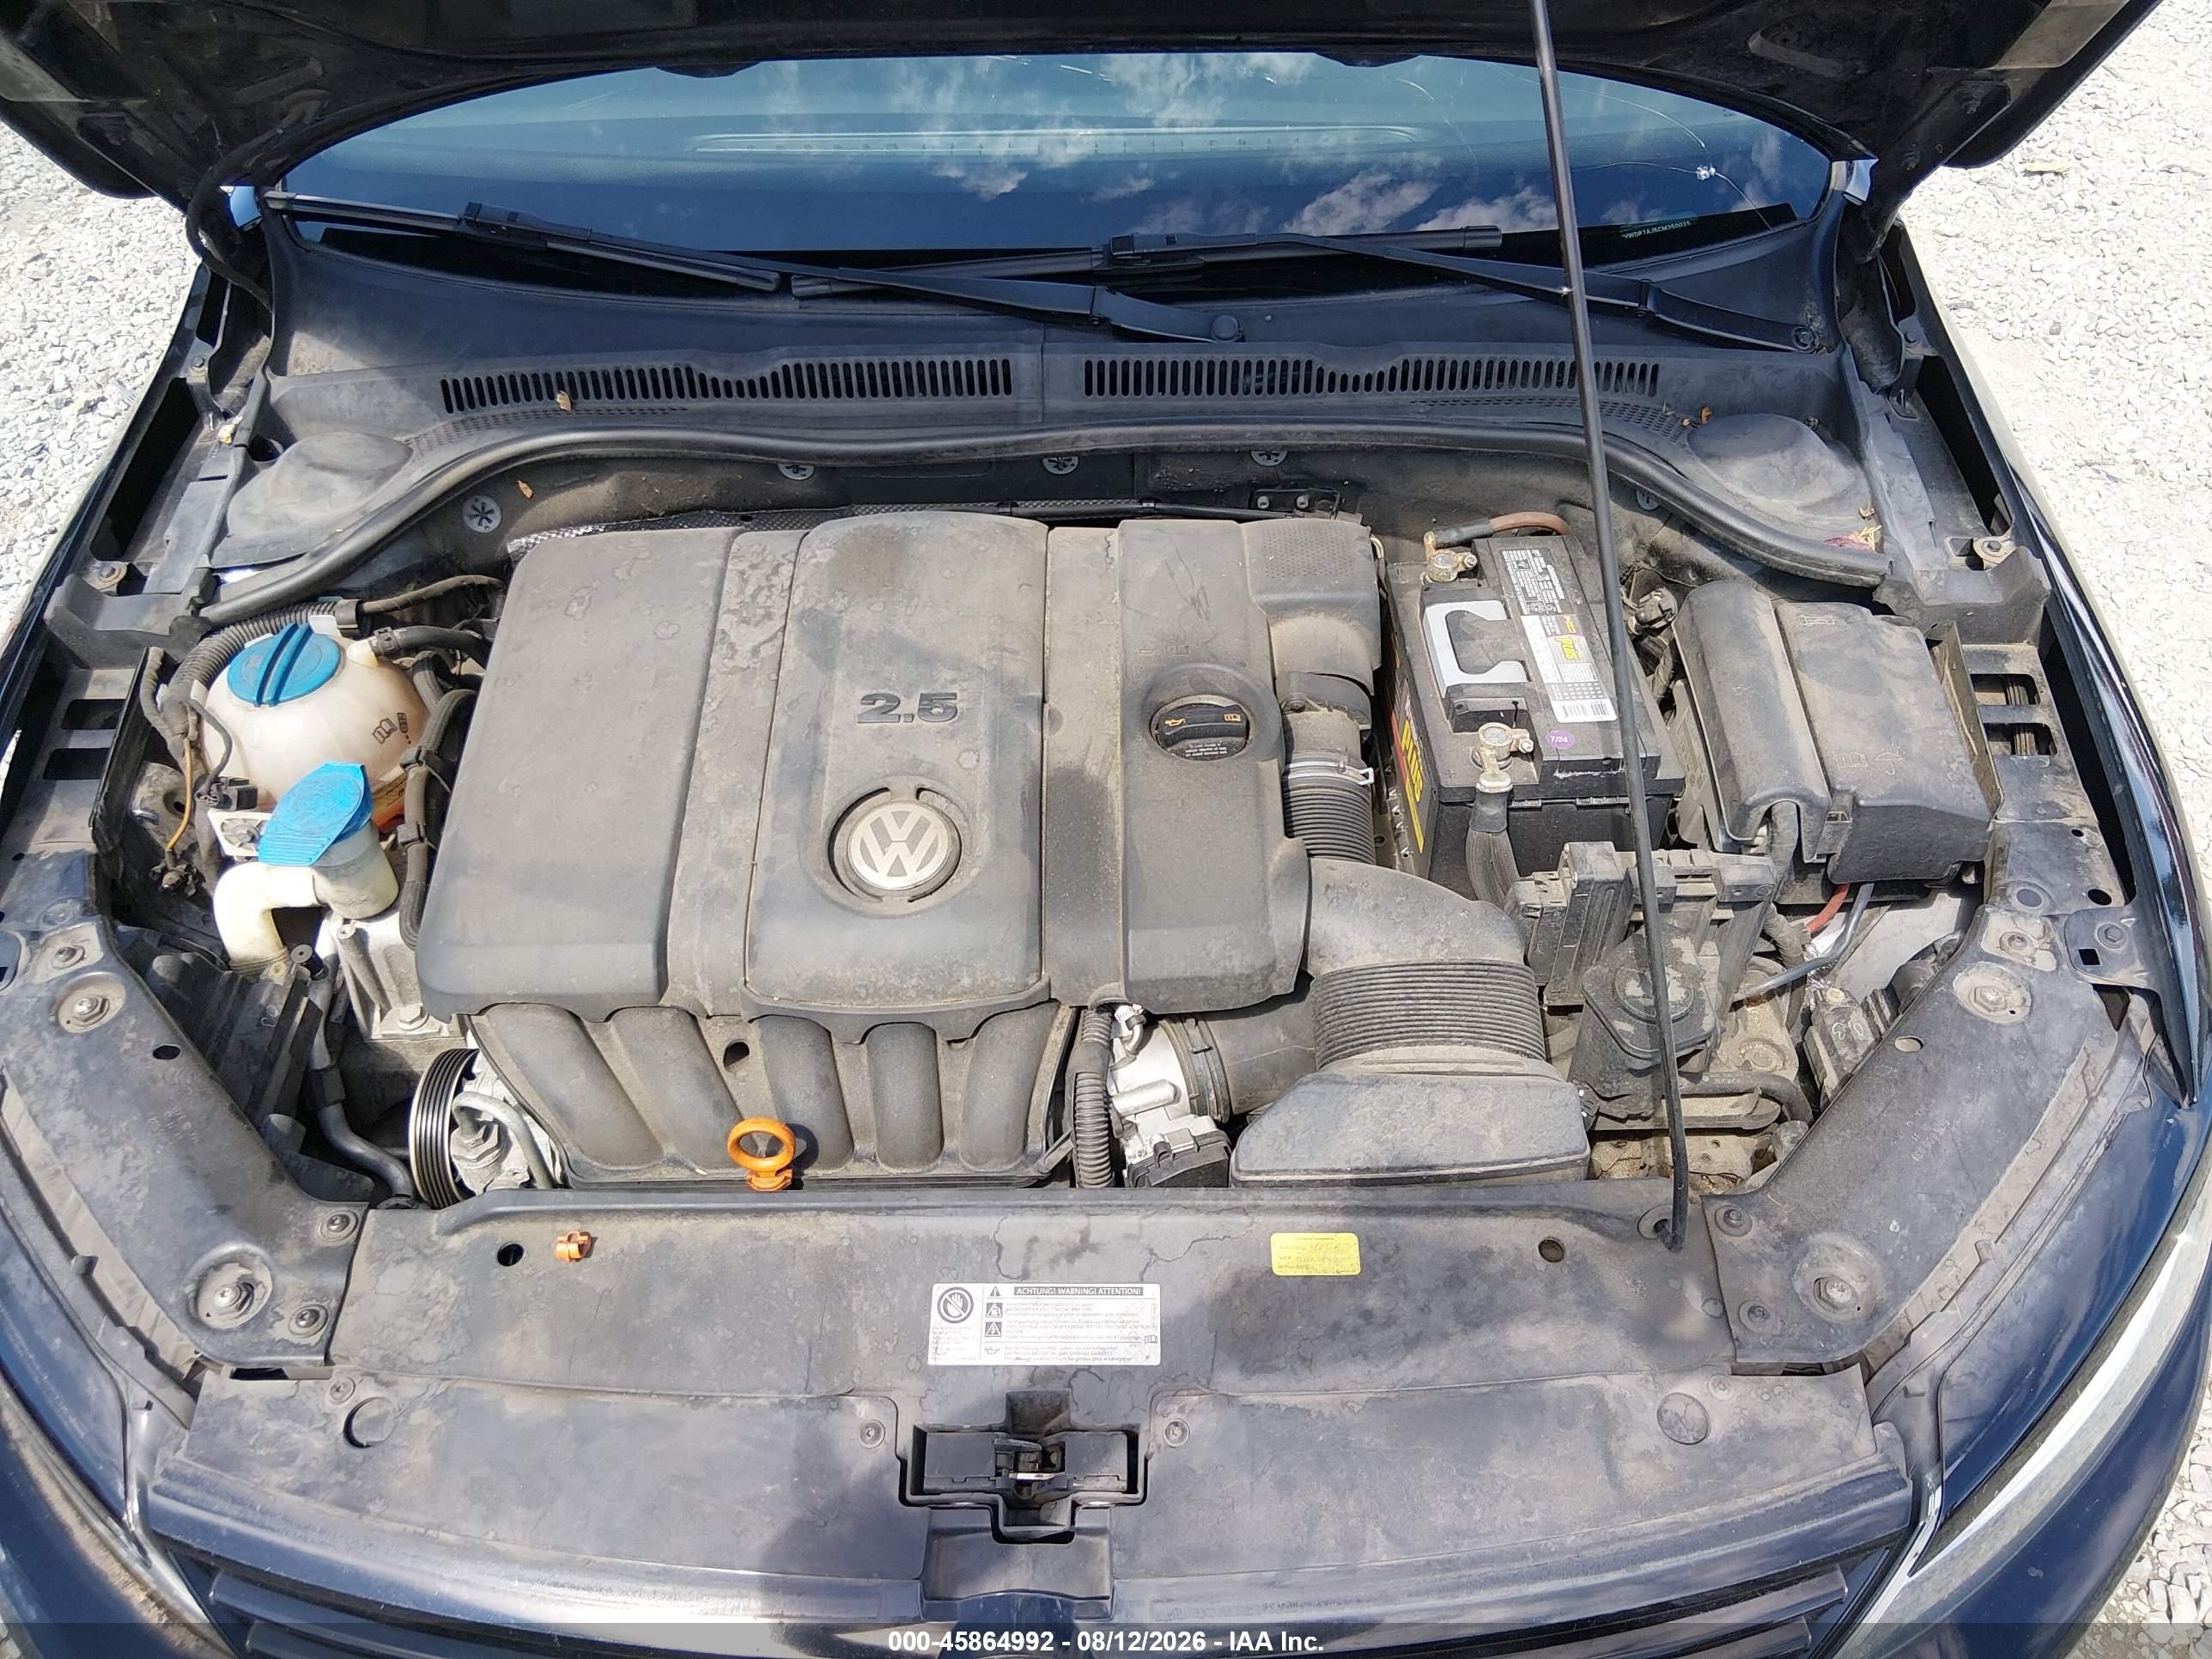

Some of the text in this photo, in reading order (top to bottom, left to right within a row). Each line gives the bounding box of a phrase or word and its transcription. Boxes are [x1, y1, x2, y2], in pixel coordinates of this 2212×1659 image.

[857, 692, 957, 723] 2.5
[848, 802, 948, 890] VW
[1016, 1287, 1141, 1296] ACHTUNG! WARNING! ATTENTION!
